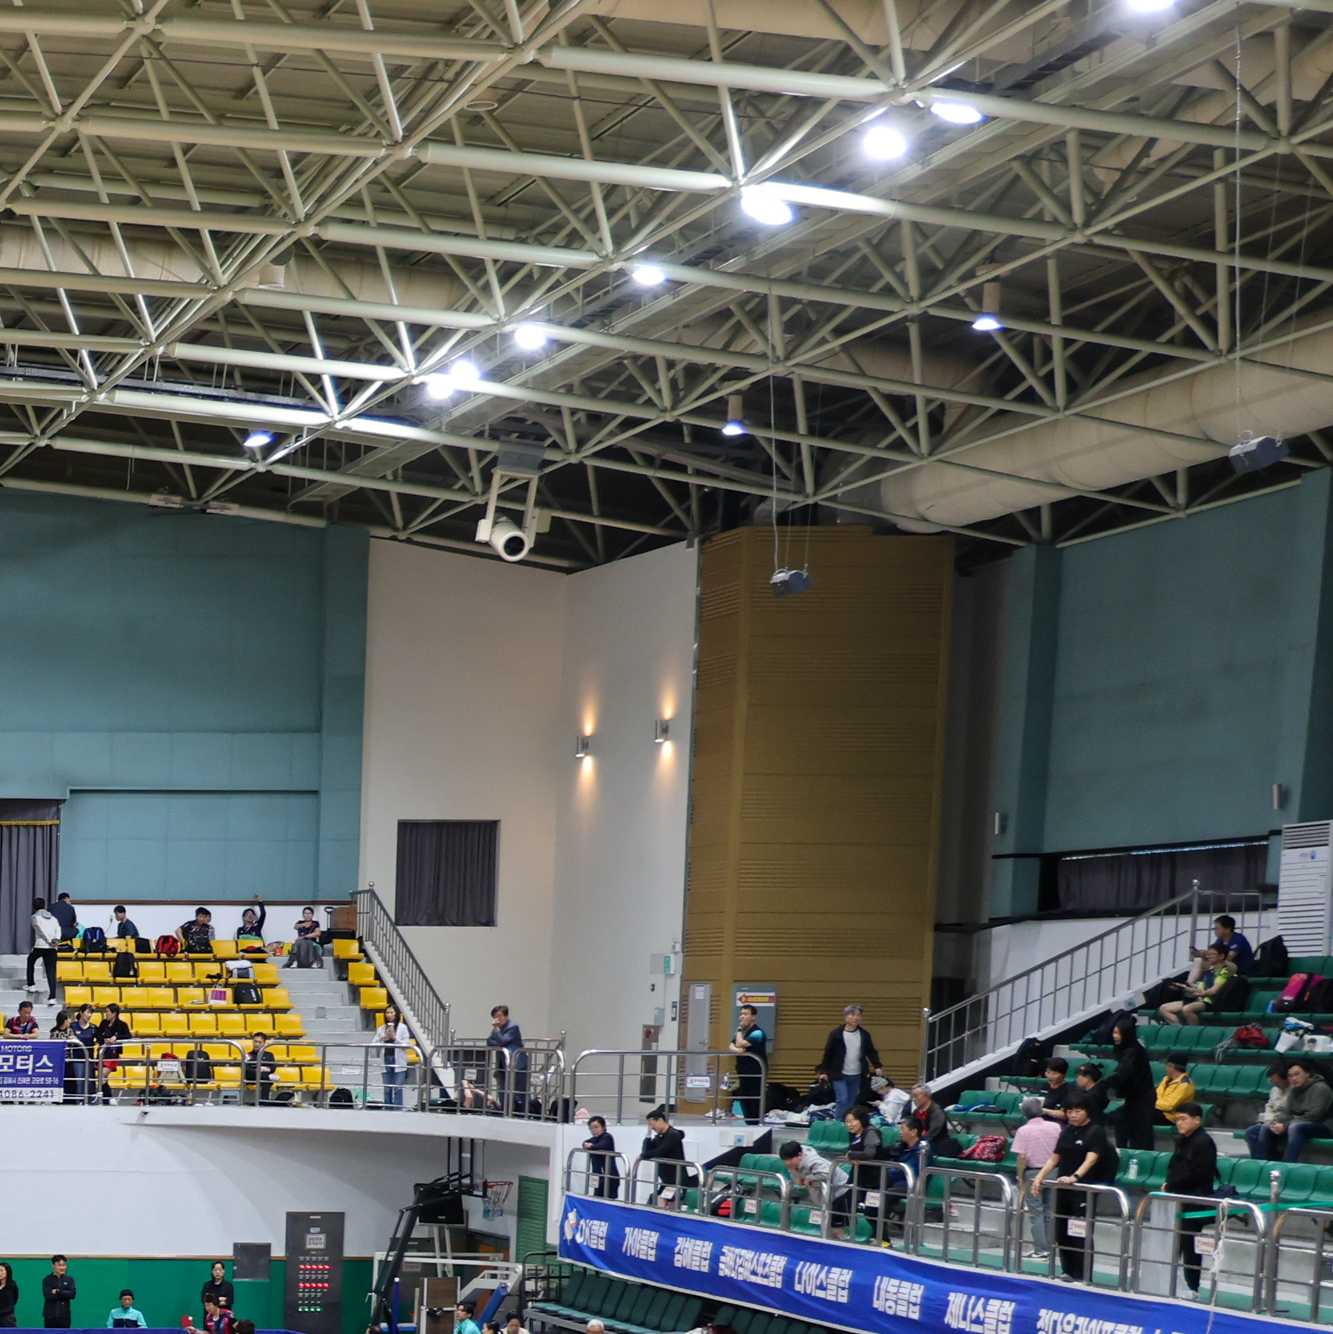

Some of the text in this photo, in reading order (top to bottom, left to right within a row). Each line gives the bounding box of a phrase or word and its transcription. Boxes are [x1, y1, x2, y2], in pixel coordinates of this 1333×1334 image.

[622, 1227, 660, 1262] 가야클럽
[674, 1237, 713, 1273] 김해클럽
[794, 1261, 853, 1303] 나이스클럽
[872, 1275, 925, 1320] 내동클럽
